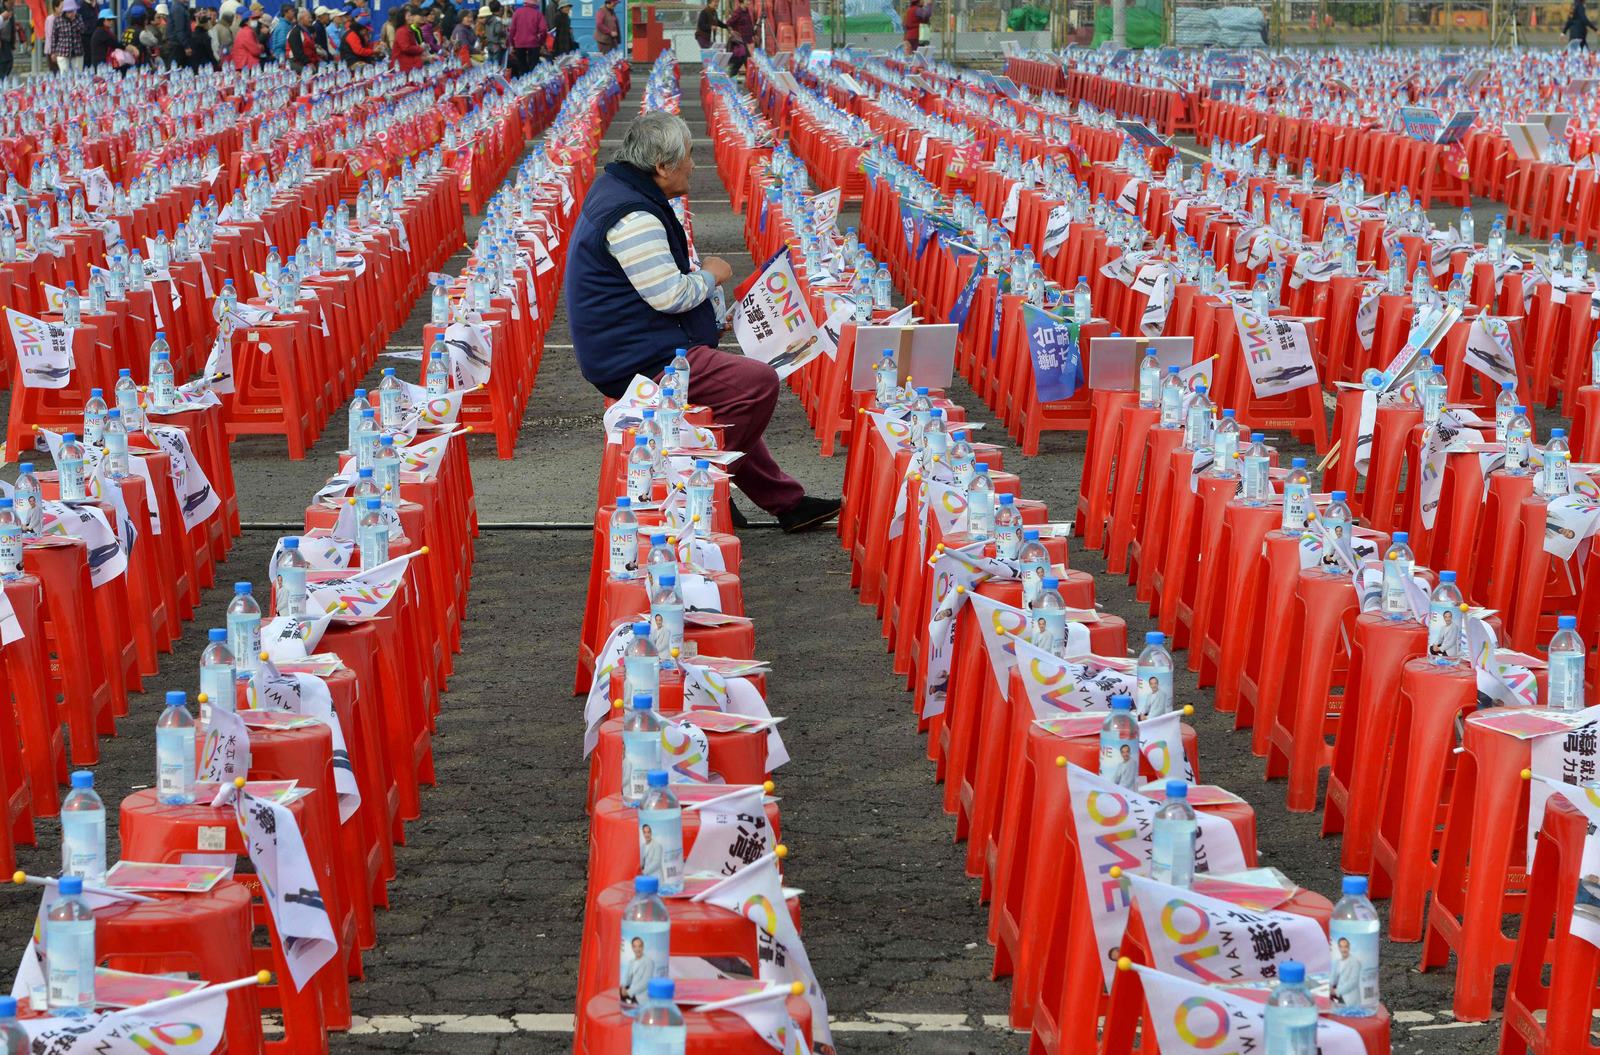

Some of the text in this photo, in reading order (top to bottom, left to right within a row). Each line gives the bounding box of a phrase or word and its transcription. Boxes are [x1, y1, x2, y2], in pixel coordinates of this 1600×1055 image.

[742, 292, 766, 325] 台灣
[757, 281, 780, 319] TAIWAN
[766, 272, 807, 333] ONE
[760, 320, 774, 337] 就是
[1508, 436, 1526, 444] ONE
[1554, 461, 1567, 469] ON
[0, 534, 20, 544] ONE
[612, 534, 632, 543] ONE
[1021, 570, 1031, 579] NE
[729, 812, 766, 866] 台灣
[775, 942, 788, 968] 是
